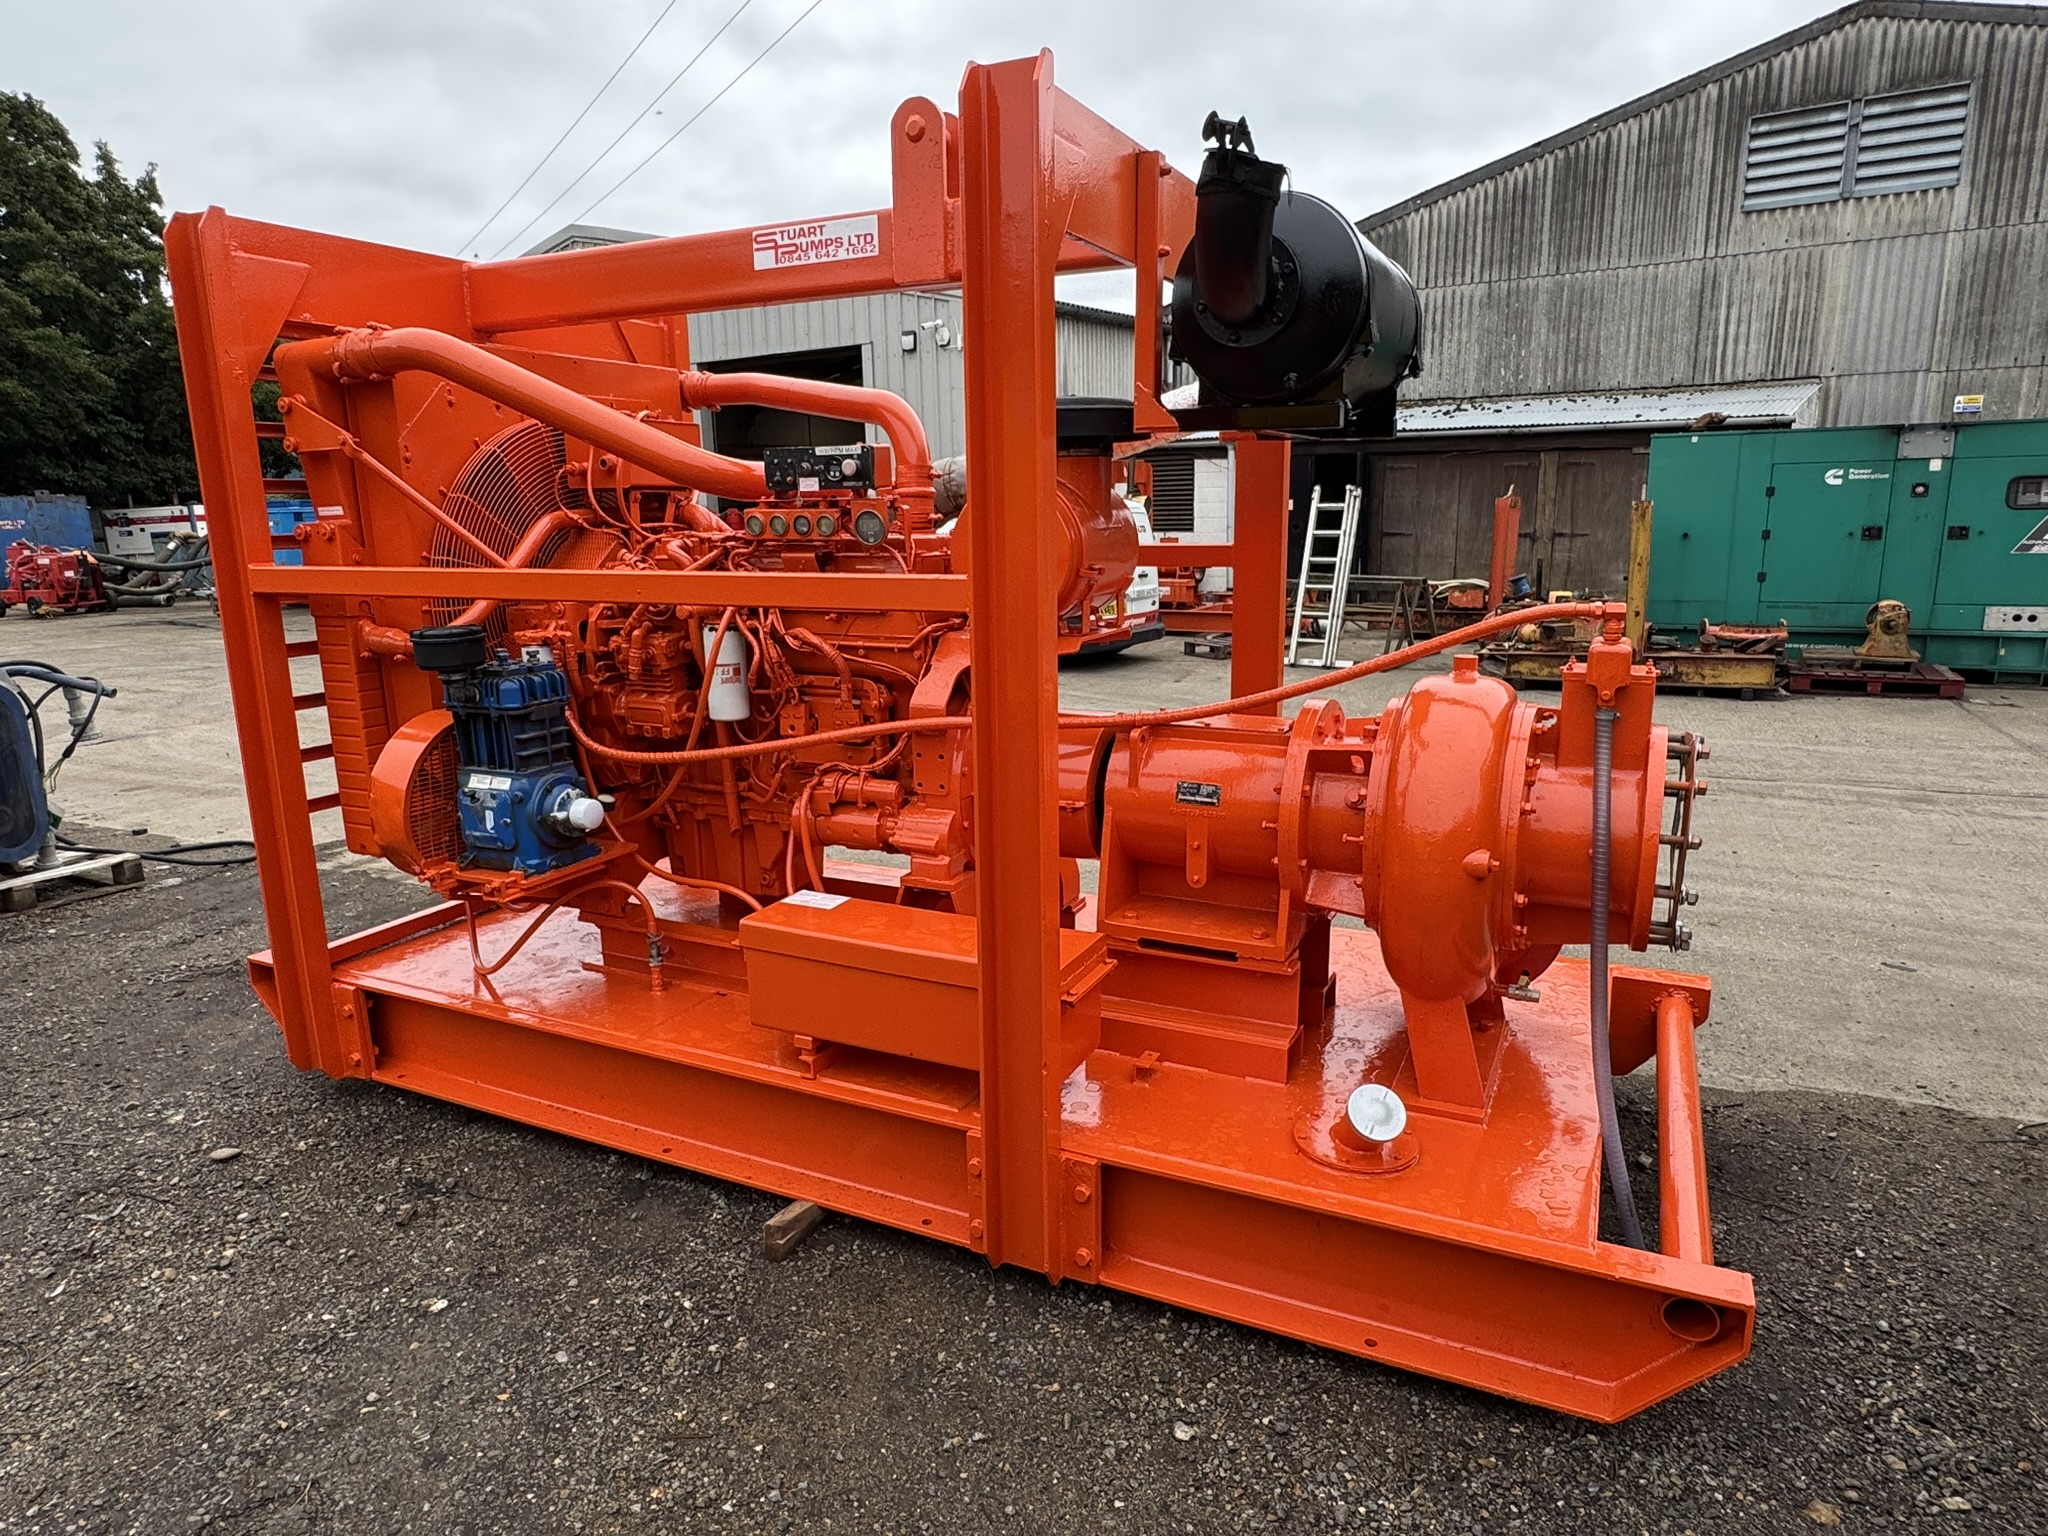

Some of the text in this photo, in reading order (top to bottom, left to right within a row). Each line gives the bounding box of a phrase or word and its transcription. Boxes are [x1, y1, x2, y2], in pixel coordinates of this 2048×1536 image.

[754, 225, 826, 252] STUART
[775, 232, 875, 265] PUMPS LTD
[779, 245, 877, 265] 0845 642 1662
[1784, 643, 1861, 651] ower.cummins.co
